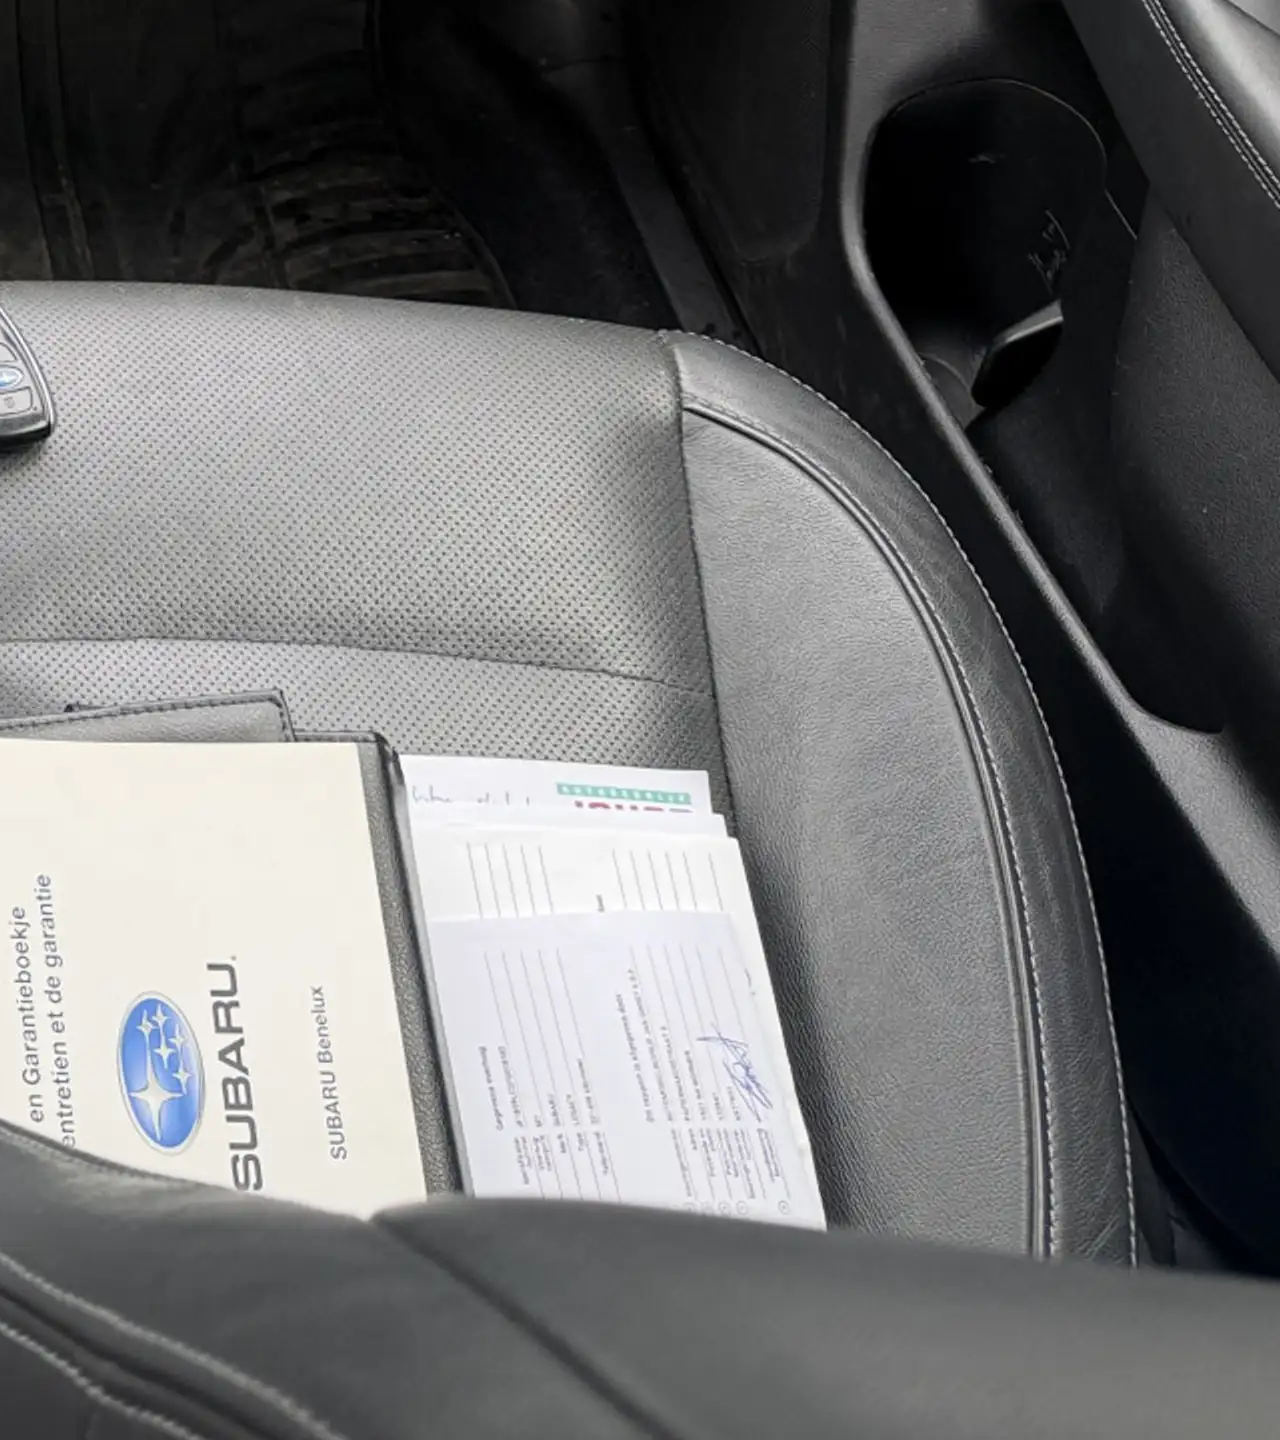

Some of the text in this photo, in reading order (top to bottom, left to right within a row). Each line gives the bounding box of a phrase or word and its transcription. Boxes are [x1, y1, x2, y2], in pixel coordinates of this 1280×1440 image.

[34, 873, 64, 967] garantie
[9, 906, 45, 1123] en Garantieboekje
[44, 975, 63, 1004] de
[47, 1009, 65, 1034] et
[206, 962, 263, 1191] SUBARU
[310, 985, 347, 1161] SUBARU Benelux
